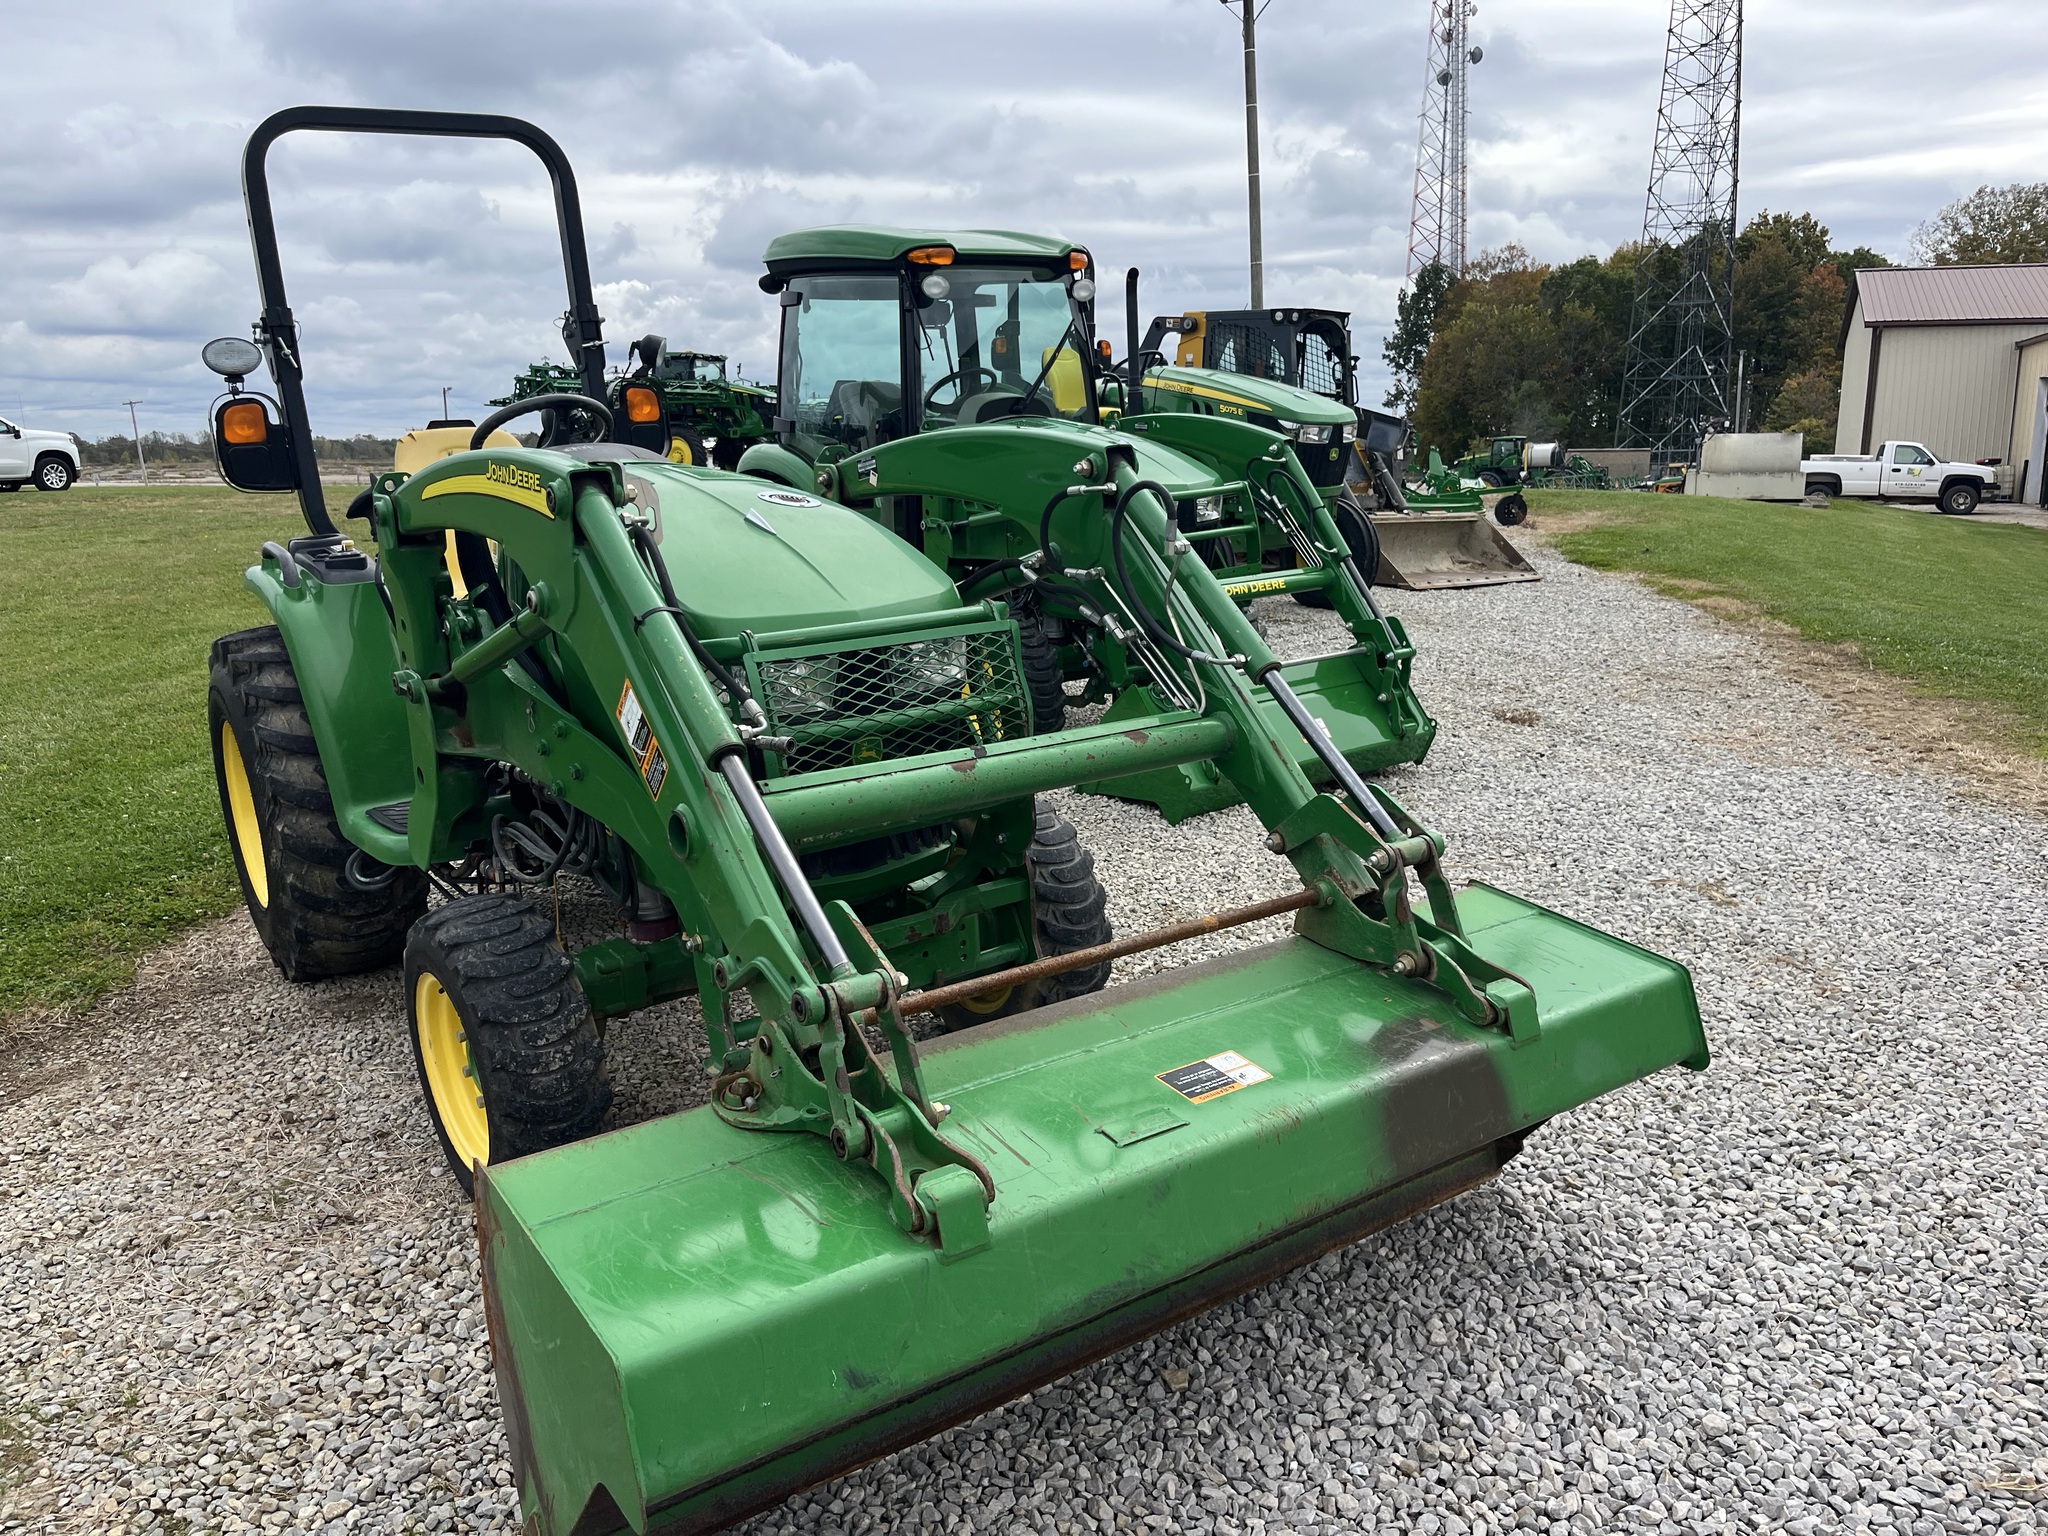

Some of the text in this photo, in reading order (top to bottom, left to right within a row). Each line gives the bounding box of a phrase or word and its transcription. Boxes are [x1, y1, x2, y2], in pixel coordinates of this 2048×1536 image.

[1163, 382, 1194, 394] JOHN DEERE
[1219, 404, 1244, 416] 5075 E
[486, 459, 541, 492] JOHN DEERE
[1224, 579, 1286, 596] OHN DEERE
